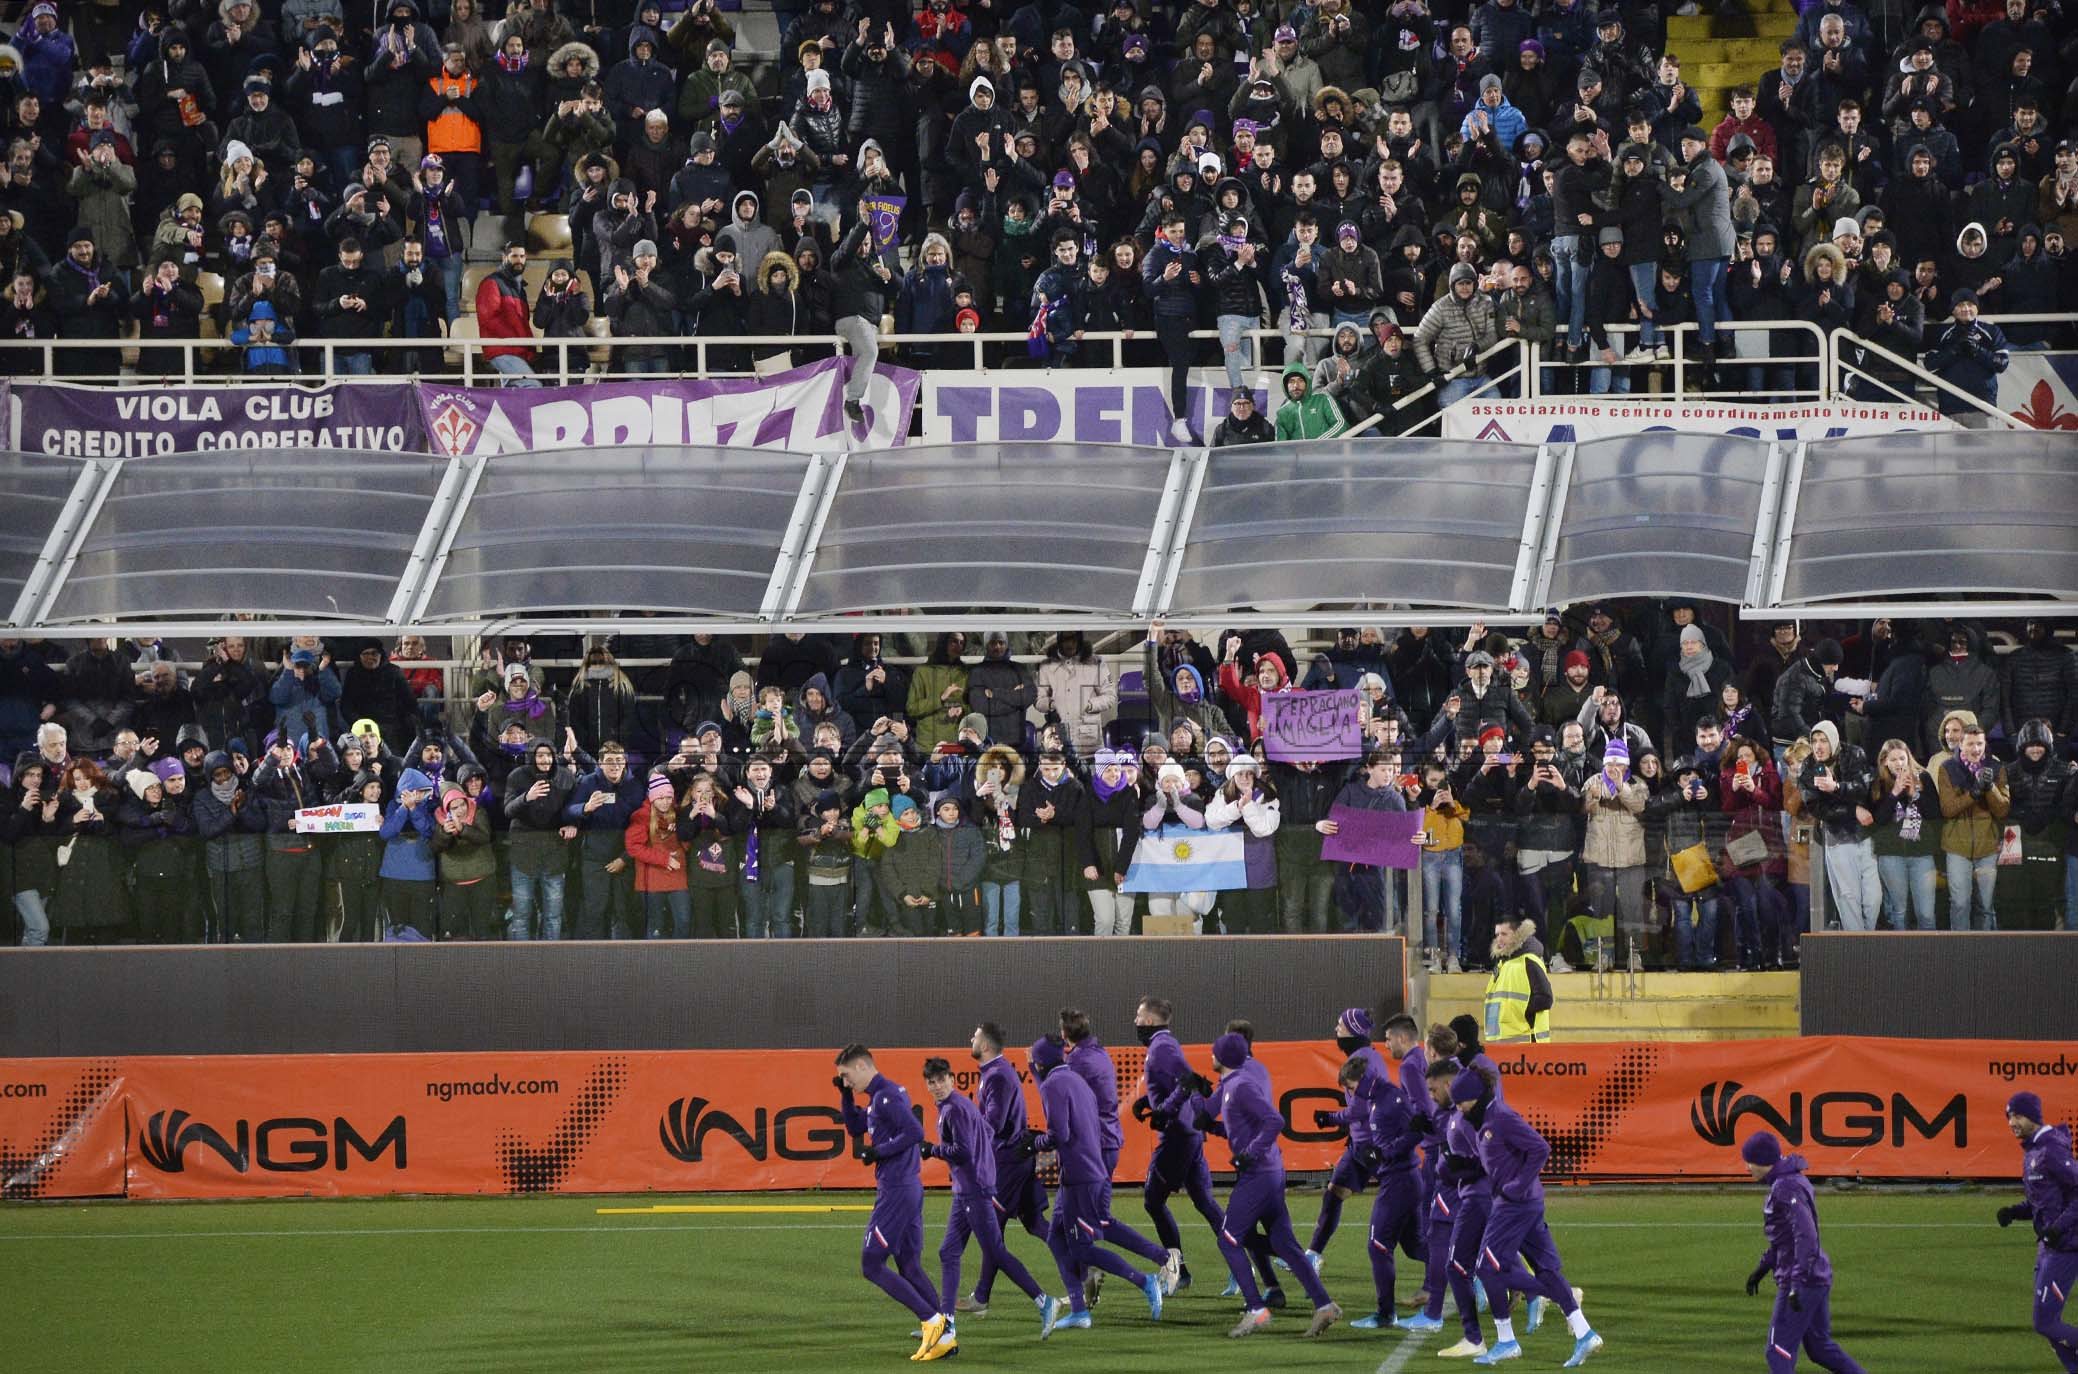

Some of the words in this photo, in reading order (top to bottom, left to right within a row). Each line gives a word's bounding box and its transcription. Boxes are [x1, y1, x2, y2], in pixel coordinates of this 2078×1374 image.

[115, 396, 223, 421] VIOLA
[245, 394, 334, 421] CLUB
[430, 393, 454, 409] VIOLA
[455, 393, 477, 412] CLUB
[1472, 404, 1600, 417] associazione
[1609, 408, 1673, 418] centro
[1681, 407, 1832, 421] coordinamento
[1841, 407, 1889, 420] viola
[42, 429, 176, 458] CREDITO
[196, 426, 405, 452] COOPERATIVO
[426, 1073, 559, 1102] ngmadv.com
[1691, 1081, 1967, 1149] NGM
[139, 1108, 407, 1172] NGM
